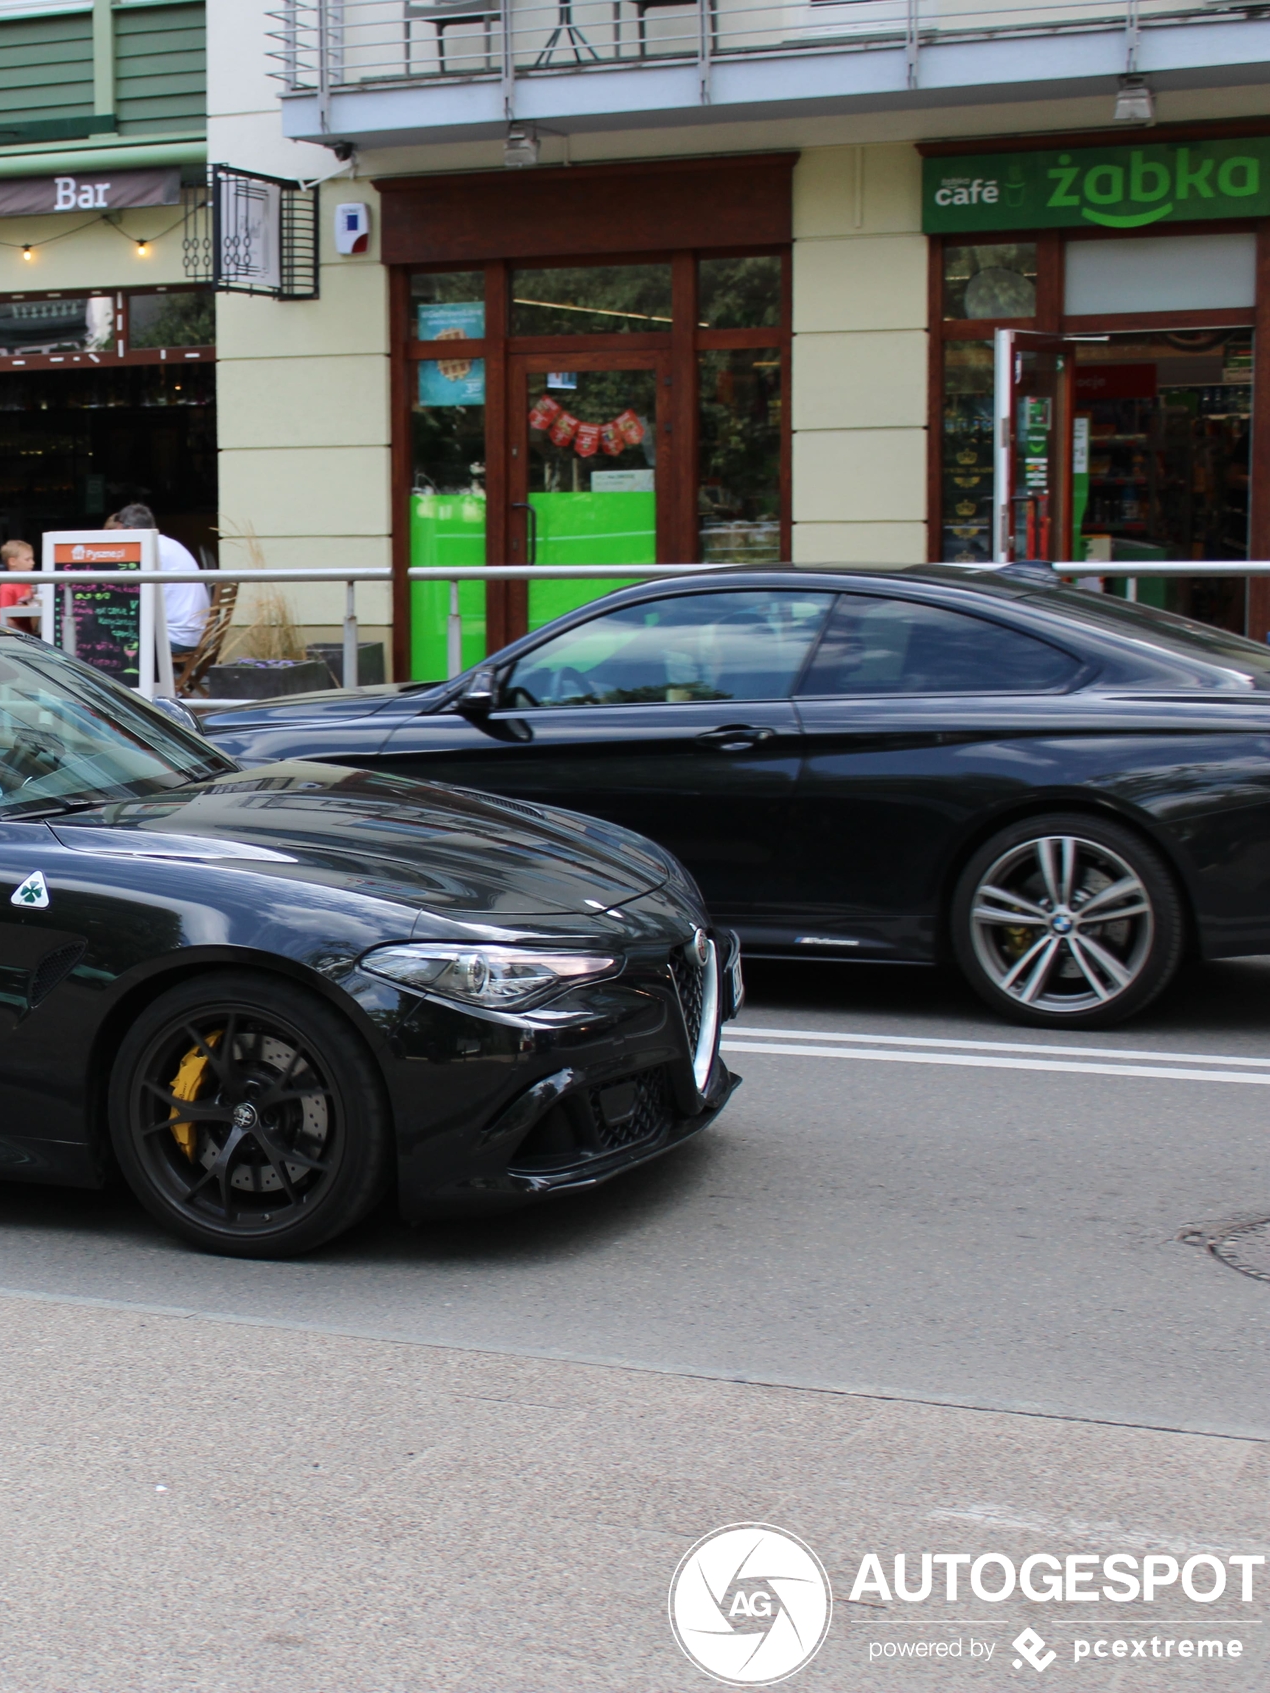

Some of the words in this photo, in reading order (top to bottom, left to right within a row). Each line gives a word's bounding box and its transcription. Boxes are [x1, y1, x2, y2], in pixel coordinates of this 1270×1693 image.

[53, 176, 111, 211] Bar
[934, 178, 1000, 207] café
[1047, 147, 1260, 208] żabka
